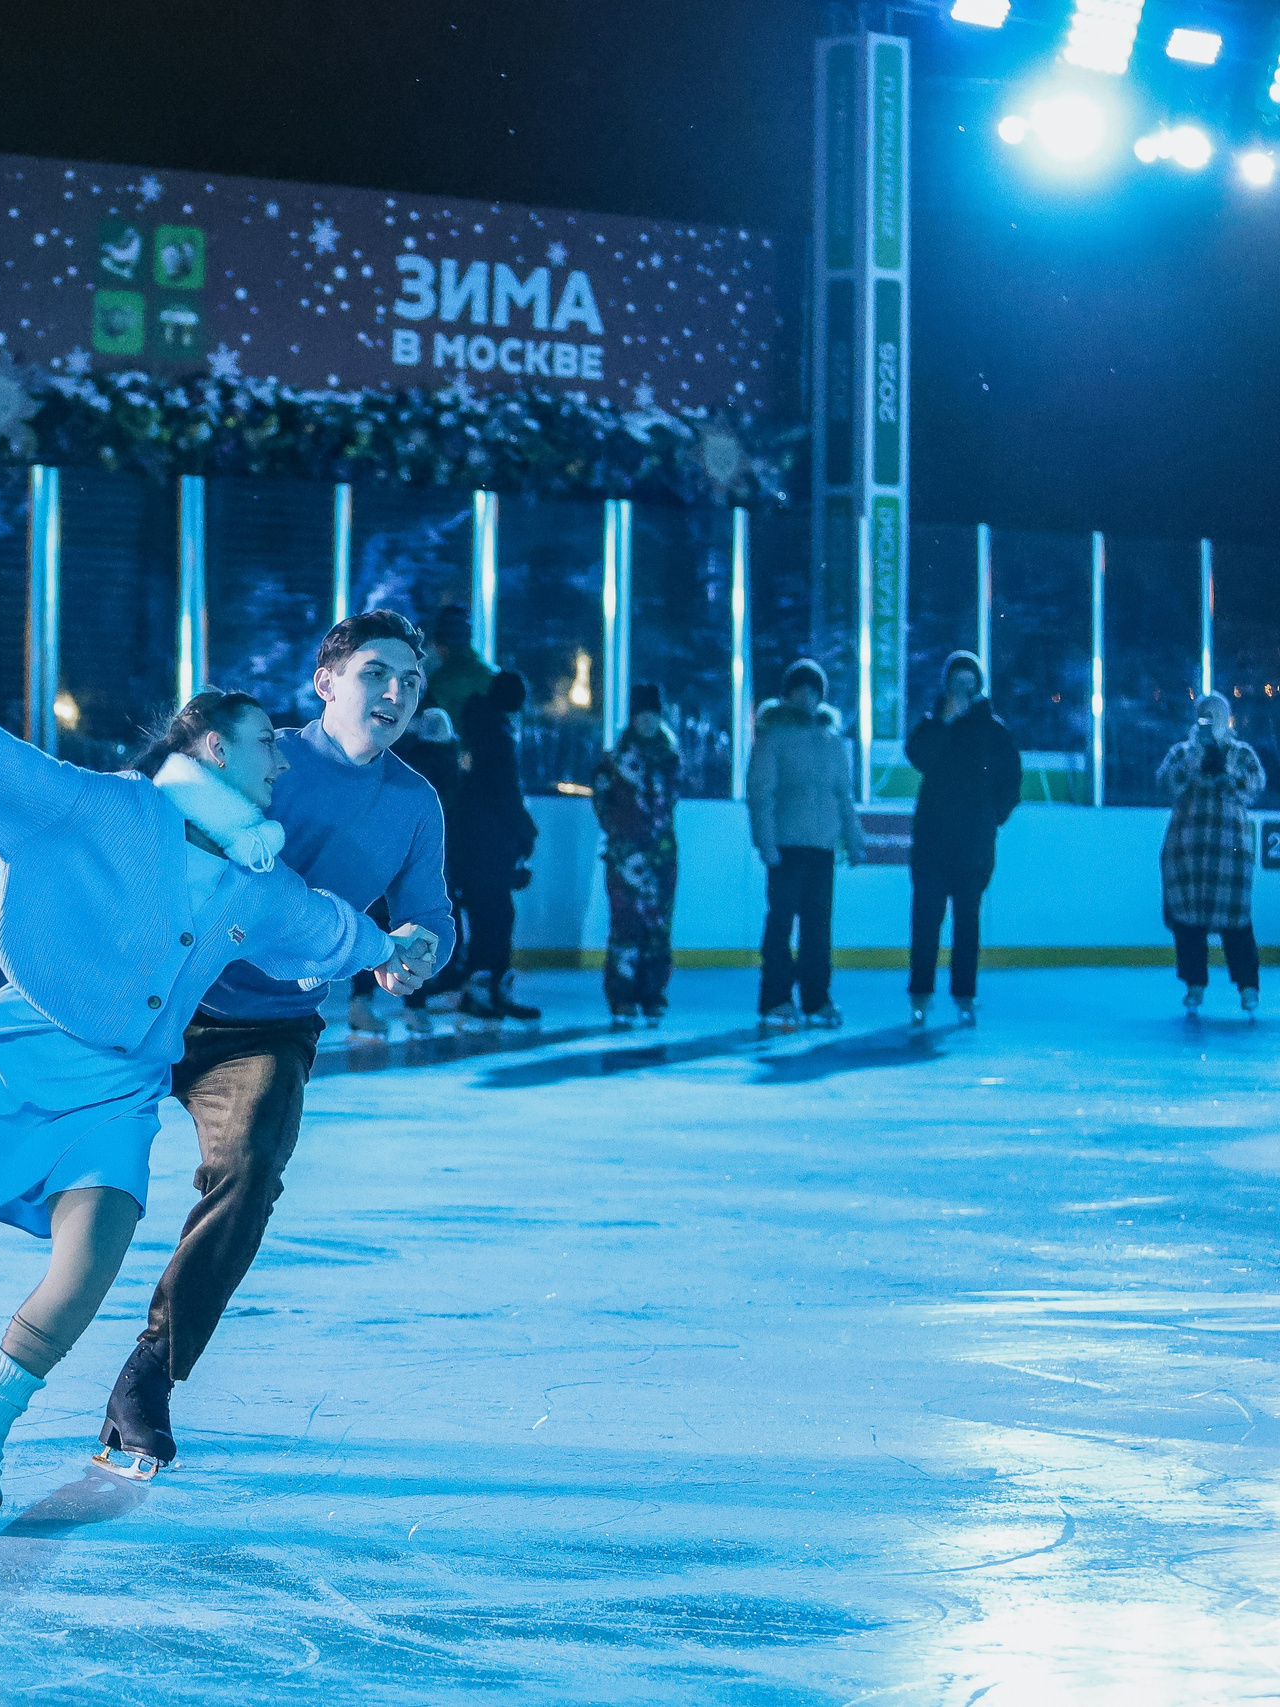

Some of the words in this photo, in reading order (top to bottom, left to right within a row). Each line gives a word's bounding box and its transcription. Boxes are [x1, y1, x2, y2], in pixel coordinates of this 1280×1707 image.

[393, 253, 605, 336] ЗИМА
[392, 328, 421, 365] В
[433, 332, 605, 380] МОСКВЕ
